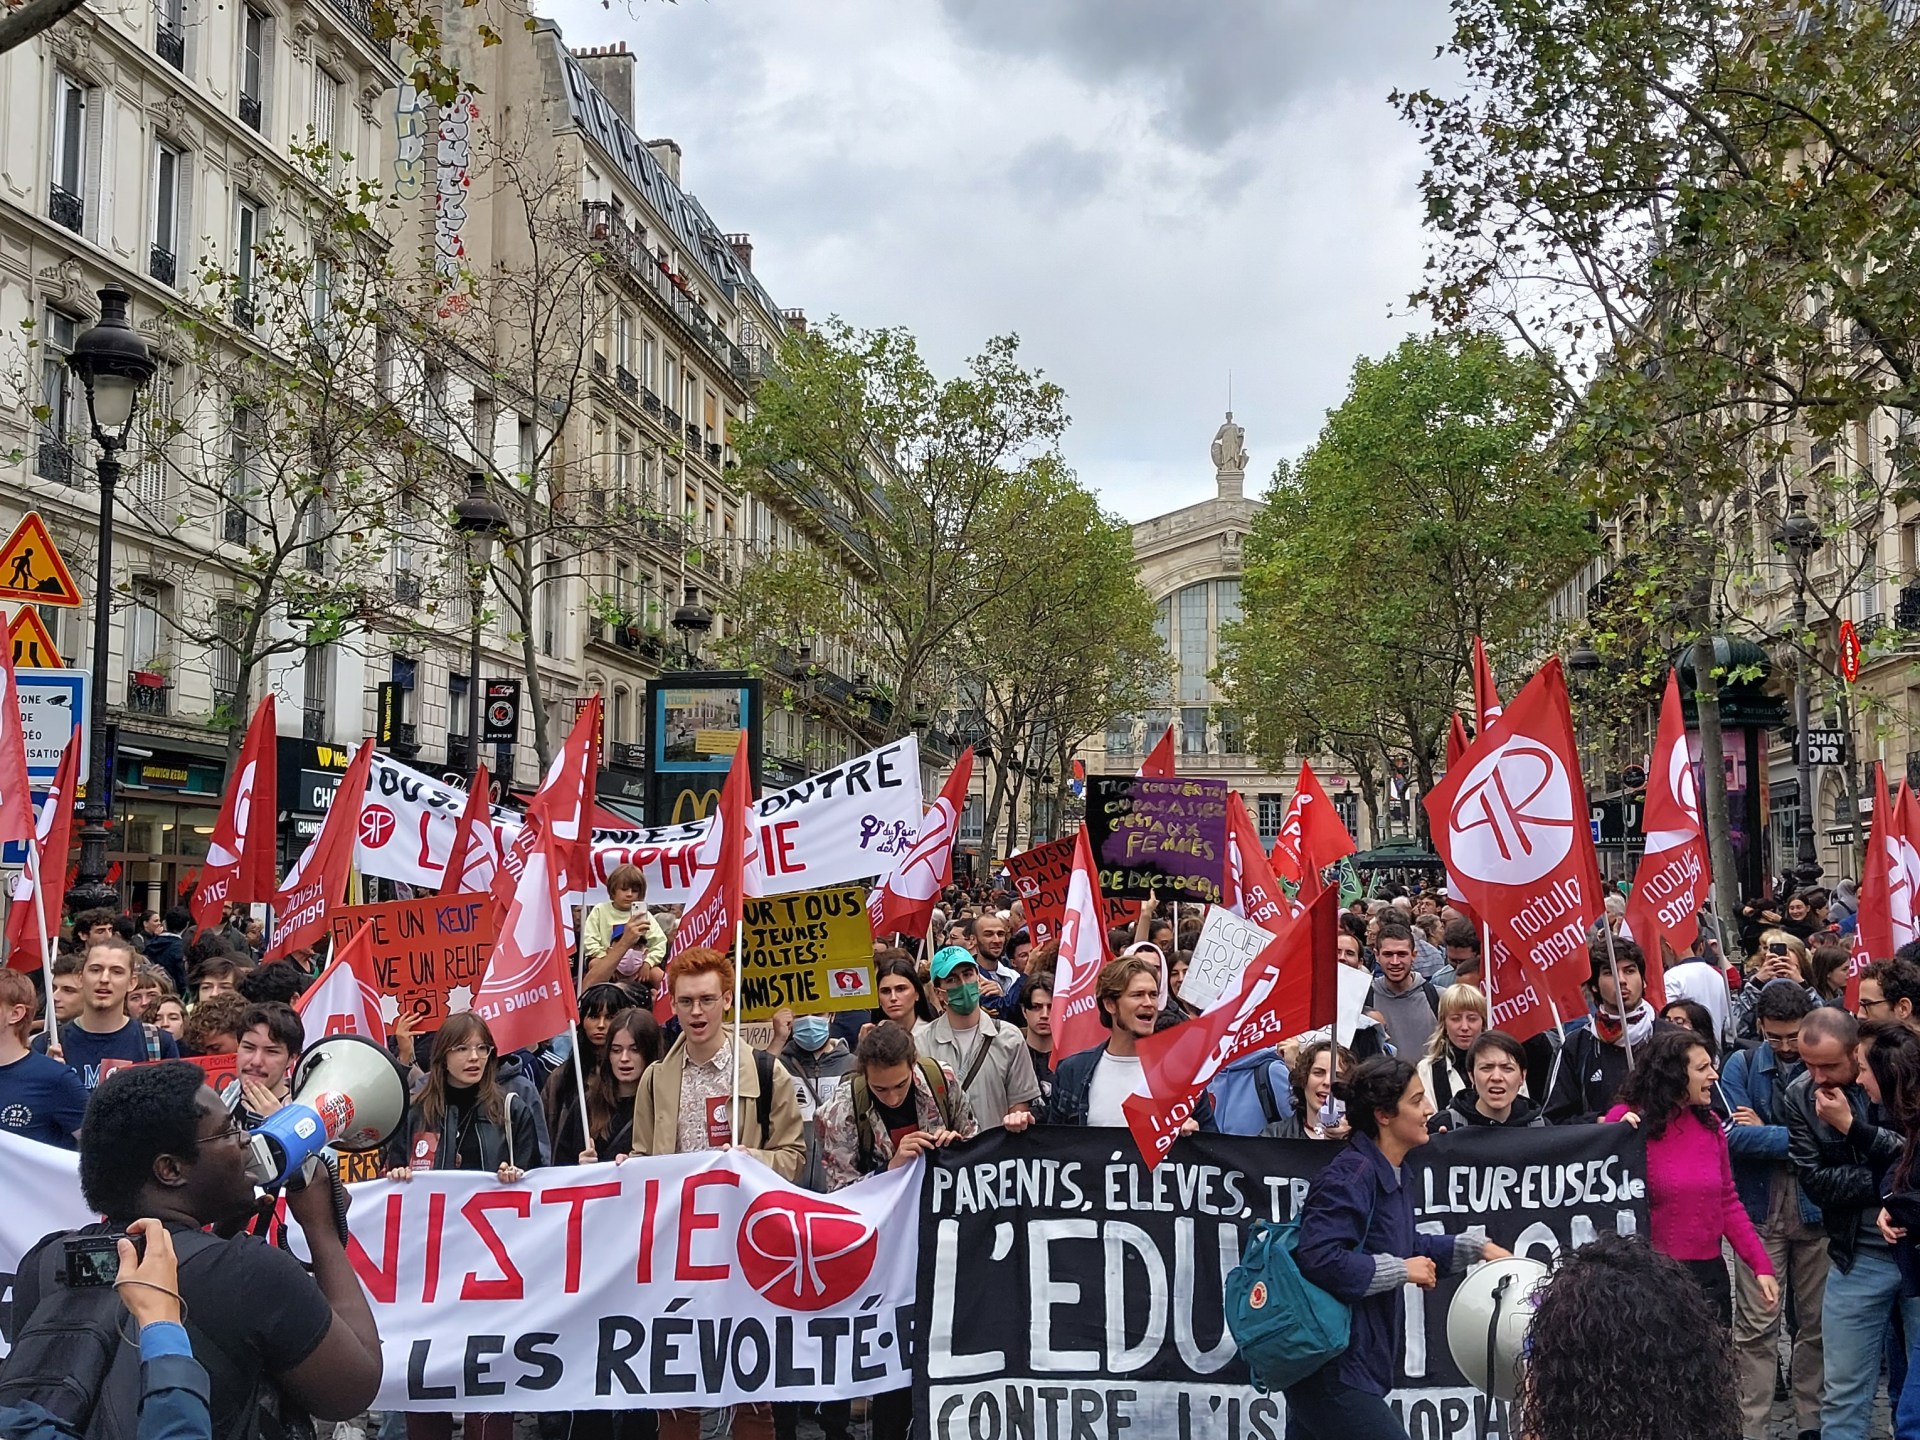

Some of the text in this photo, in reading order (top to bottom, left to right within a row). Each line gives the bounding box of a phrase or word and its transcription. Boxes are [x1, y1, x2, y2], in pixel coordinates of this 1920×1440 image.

[20, 713, 34, 722] DE
[759, 745, 903, 818] ONTRE
[298, 821, 321, 834] CHANG
[1011, 847, 1058, 877] PLUS
[1126, 831, 1216, 861] FEMMES
[1099, 869, 1125, 891] DE
[397, 908, 425, 938] UN
[436, 903, 484, 934] KEUF
[743, 900, 777, 927] UR
[777, 891, 862, 926] TOUS
[752, 921, 829, 949] JEUNES
[409, 950, 436, 985] UN
[444, 943, 493, 981] REUF
[10, 1109, 23, 1117] 37
[932, 1158, 1093, 1214] PARENTS,
[1617, 1170, 1646, 1200] de
[346, 1168, 741, 1304] NISTIE
[407, 1332, 565, 1401] LES
[935, 1385, 1138, 1440] CONTRE
